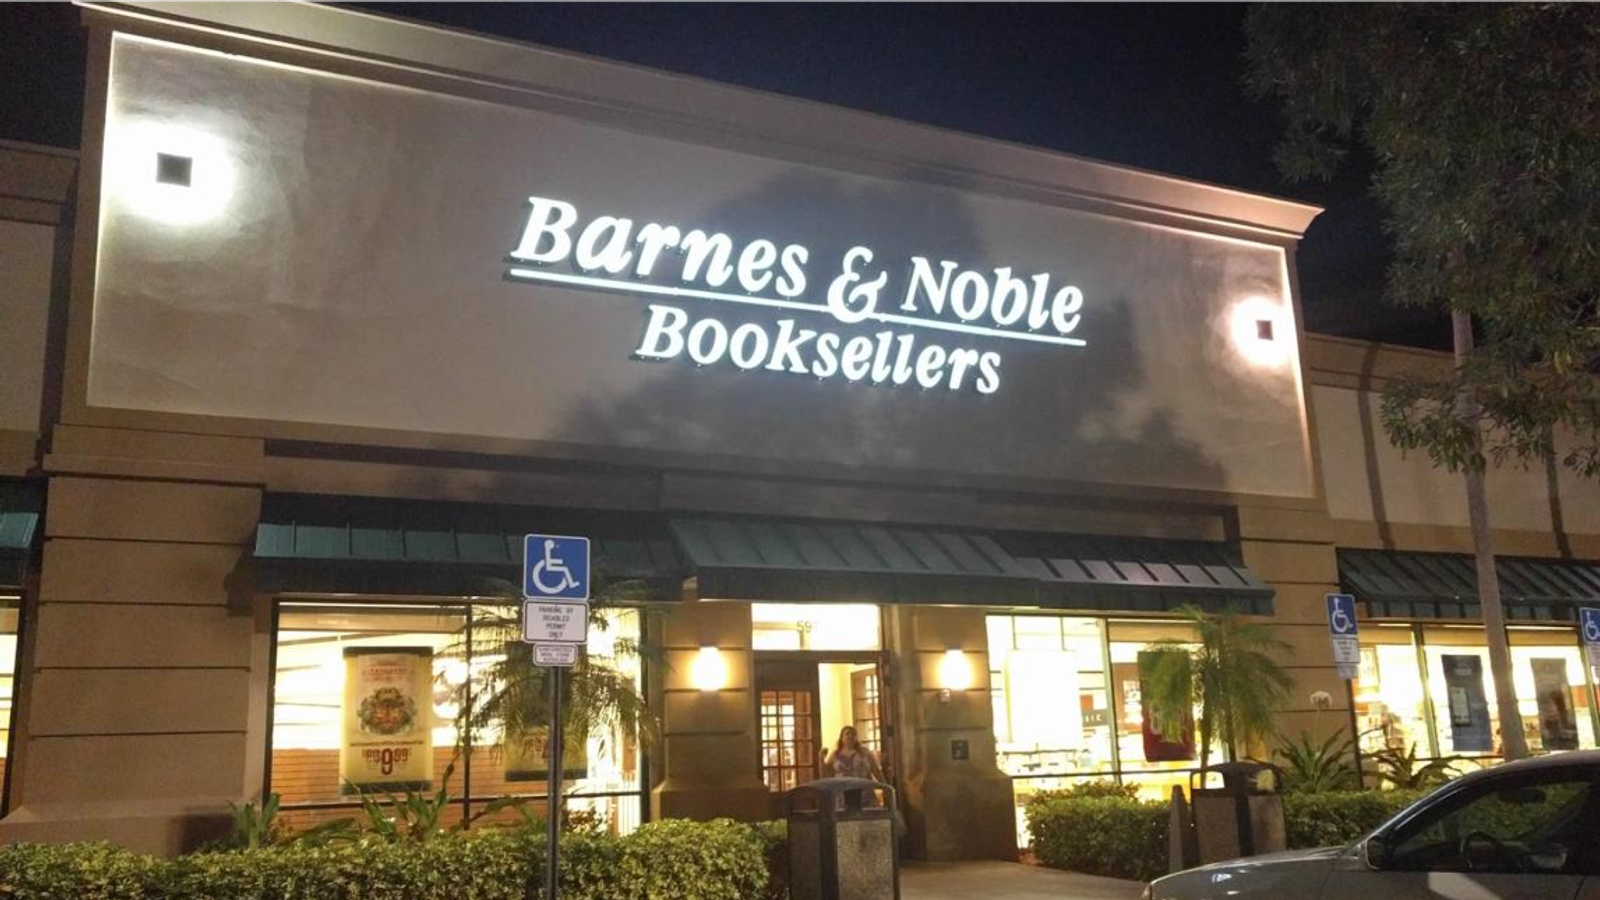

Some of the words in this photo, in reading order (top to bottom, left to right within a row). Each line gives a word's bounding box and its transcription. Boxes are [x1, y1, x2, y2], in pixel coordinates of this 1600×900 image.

[509, 195, 809, 300] Barnes
[826, 245, 888, 323] &
[899, 256, 1084, 336] Noble
[634, 303, 1002, 394] Booksellers
